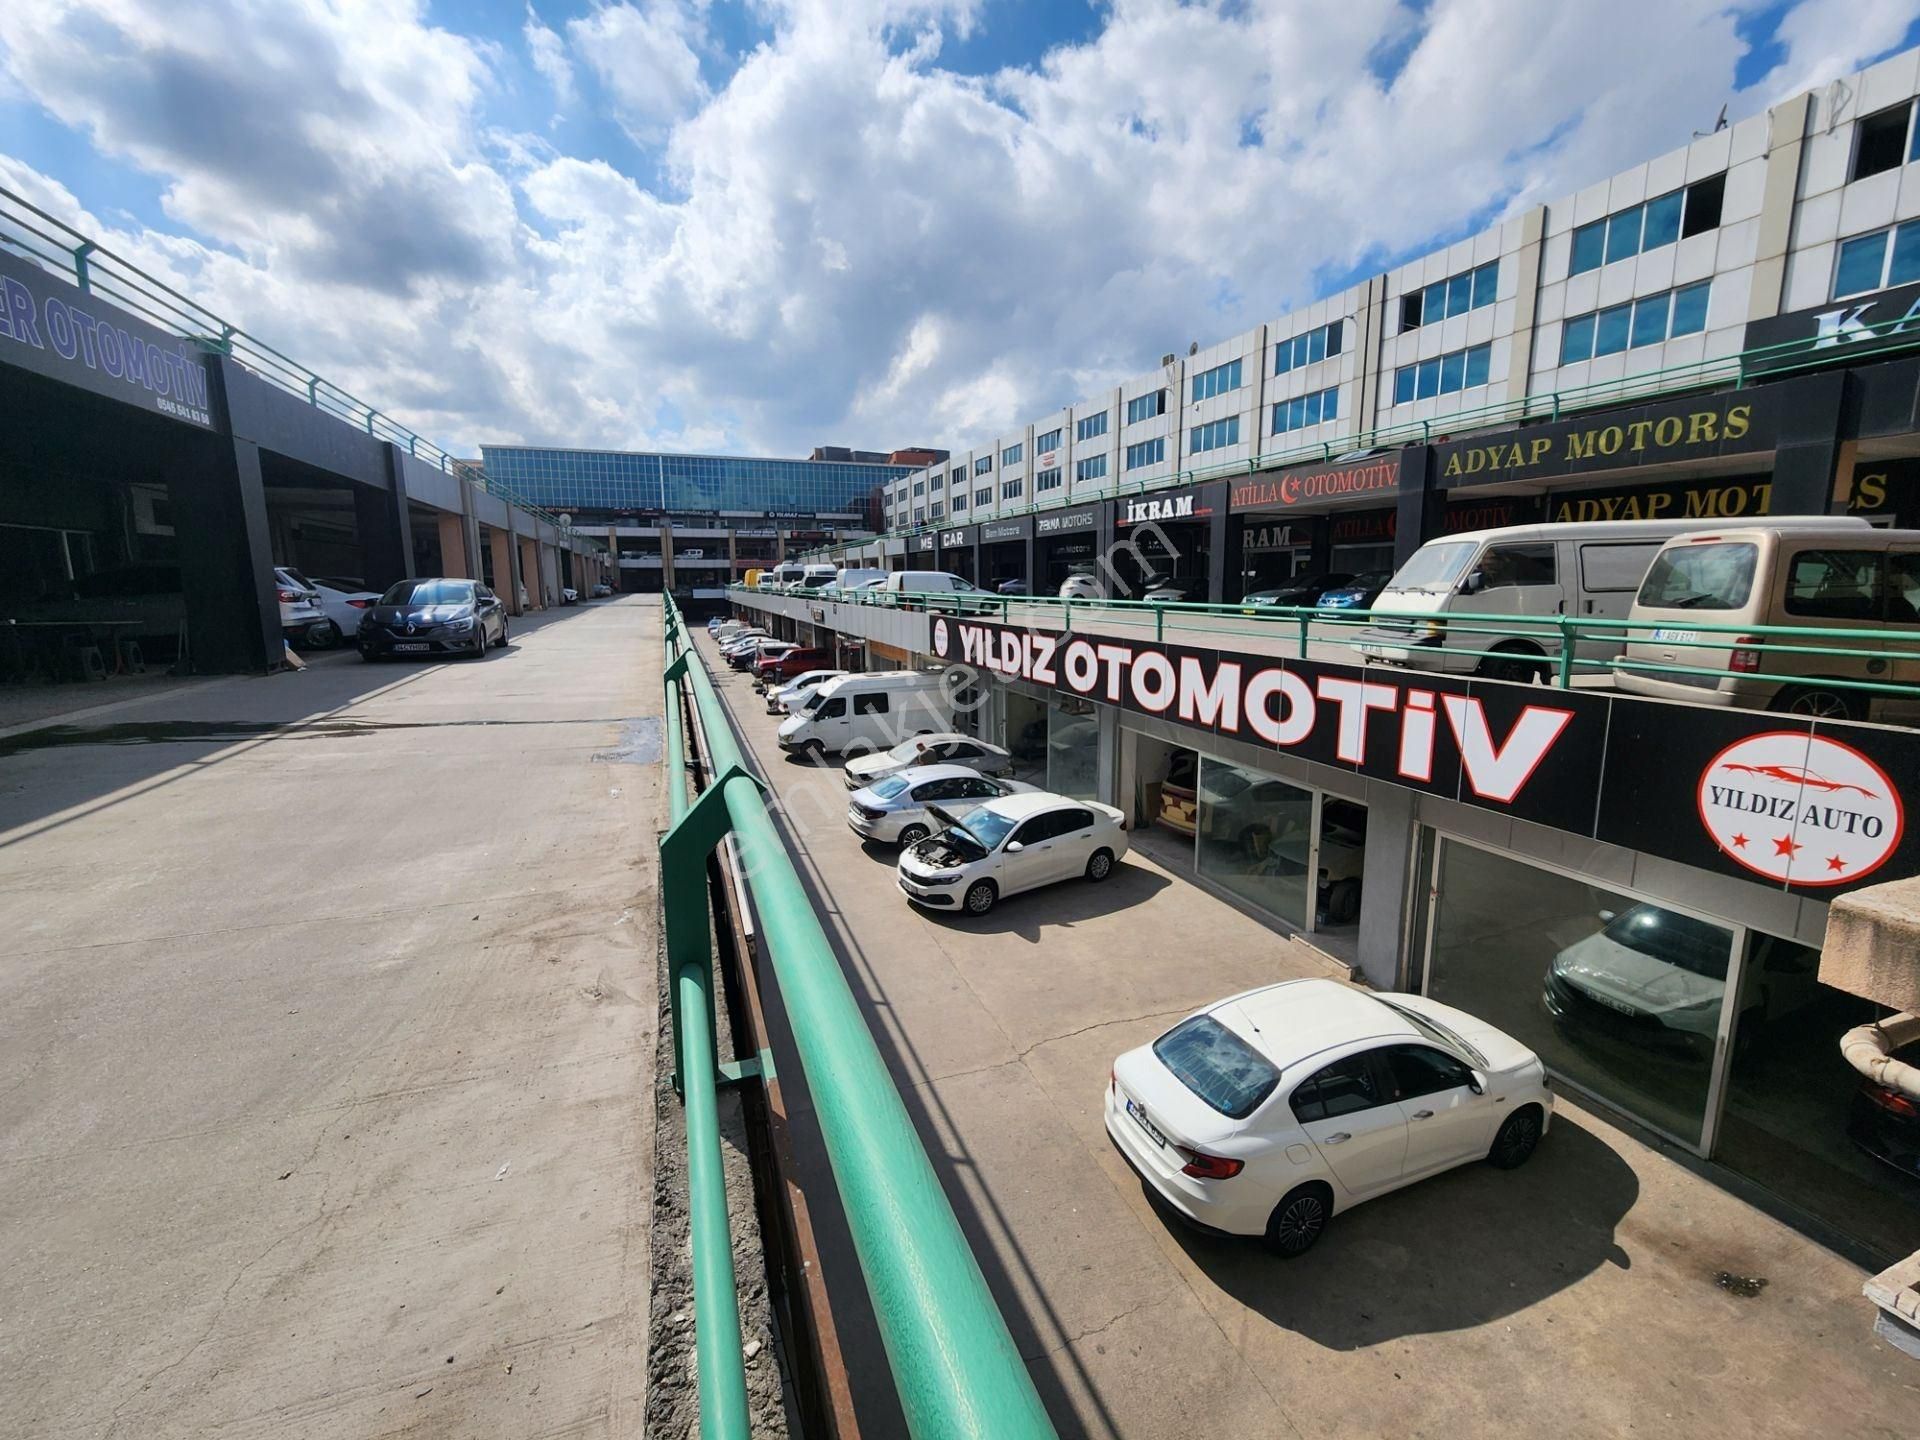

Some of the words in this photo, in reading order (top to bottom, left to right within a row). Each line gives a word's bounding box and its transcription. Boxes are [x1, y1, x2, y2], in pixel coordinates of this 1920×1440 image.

[1444, 437, 1552, 477] ADYAP
[1564, 404, 1752, 461] MOTORS
[1231, 481, 1279, 507] ATİLLA
[1555, 493, 1672, 523] ADYAP
[1061, 513, 1093, 529] MOTORS
[1127, 495, 1194, 523] İKRAM
[920, 536, 932, 550] MS
[943, 531, 964, 547] CAR
[959, 624, 1057, 685] YILDIZ
[1710, 785, 1796, 821] YILDIZ
[1801, 804, 1884, 839] AUTO
